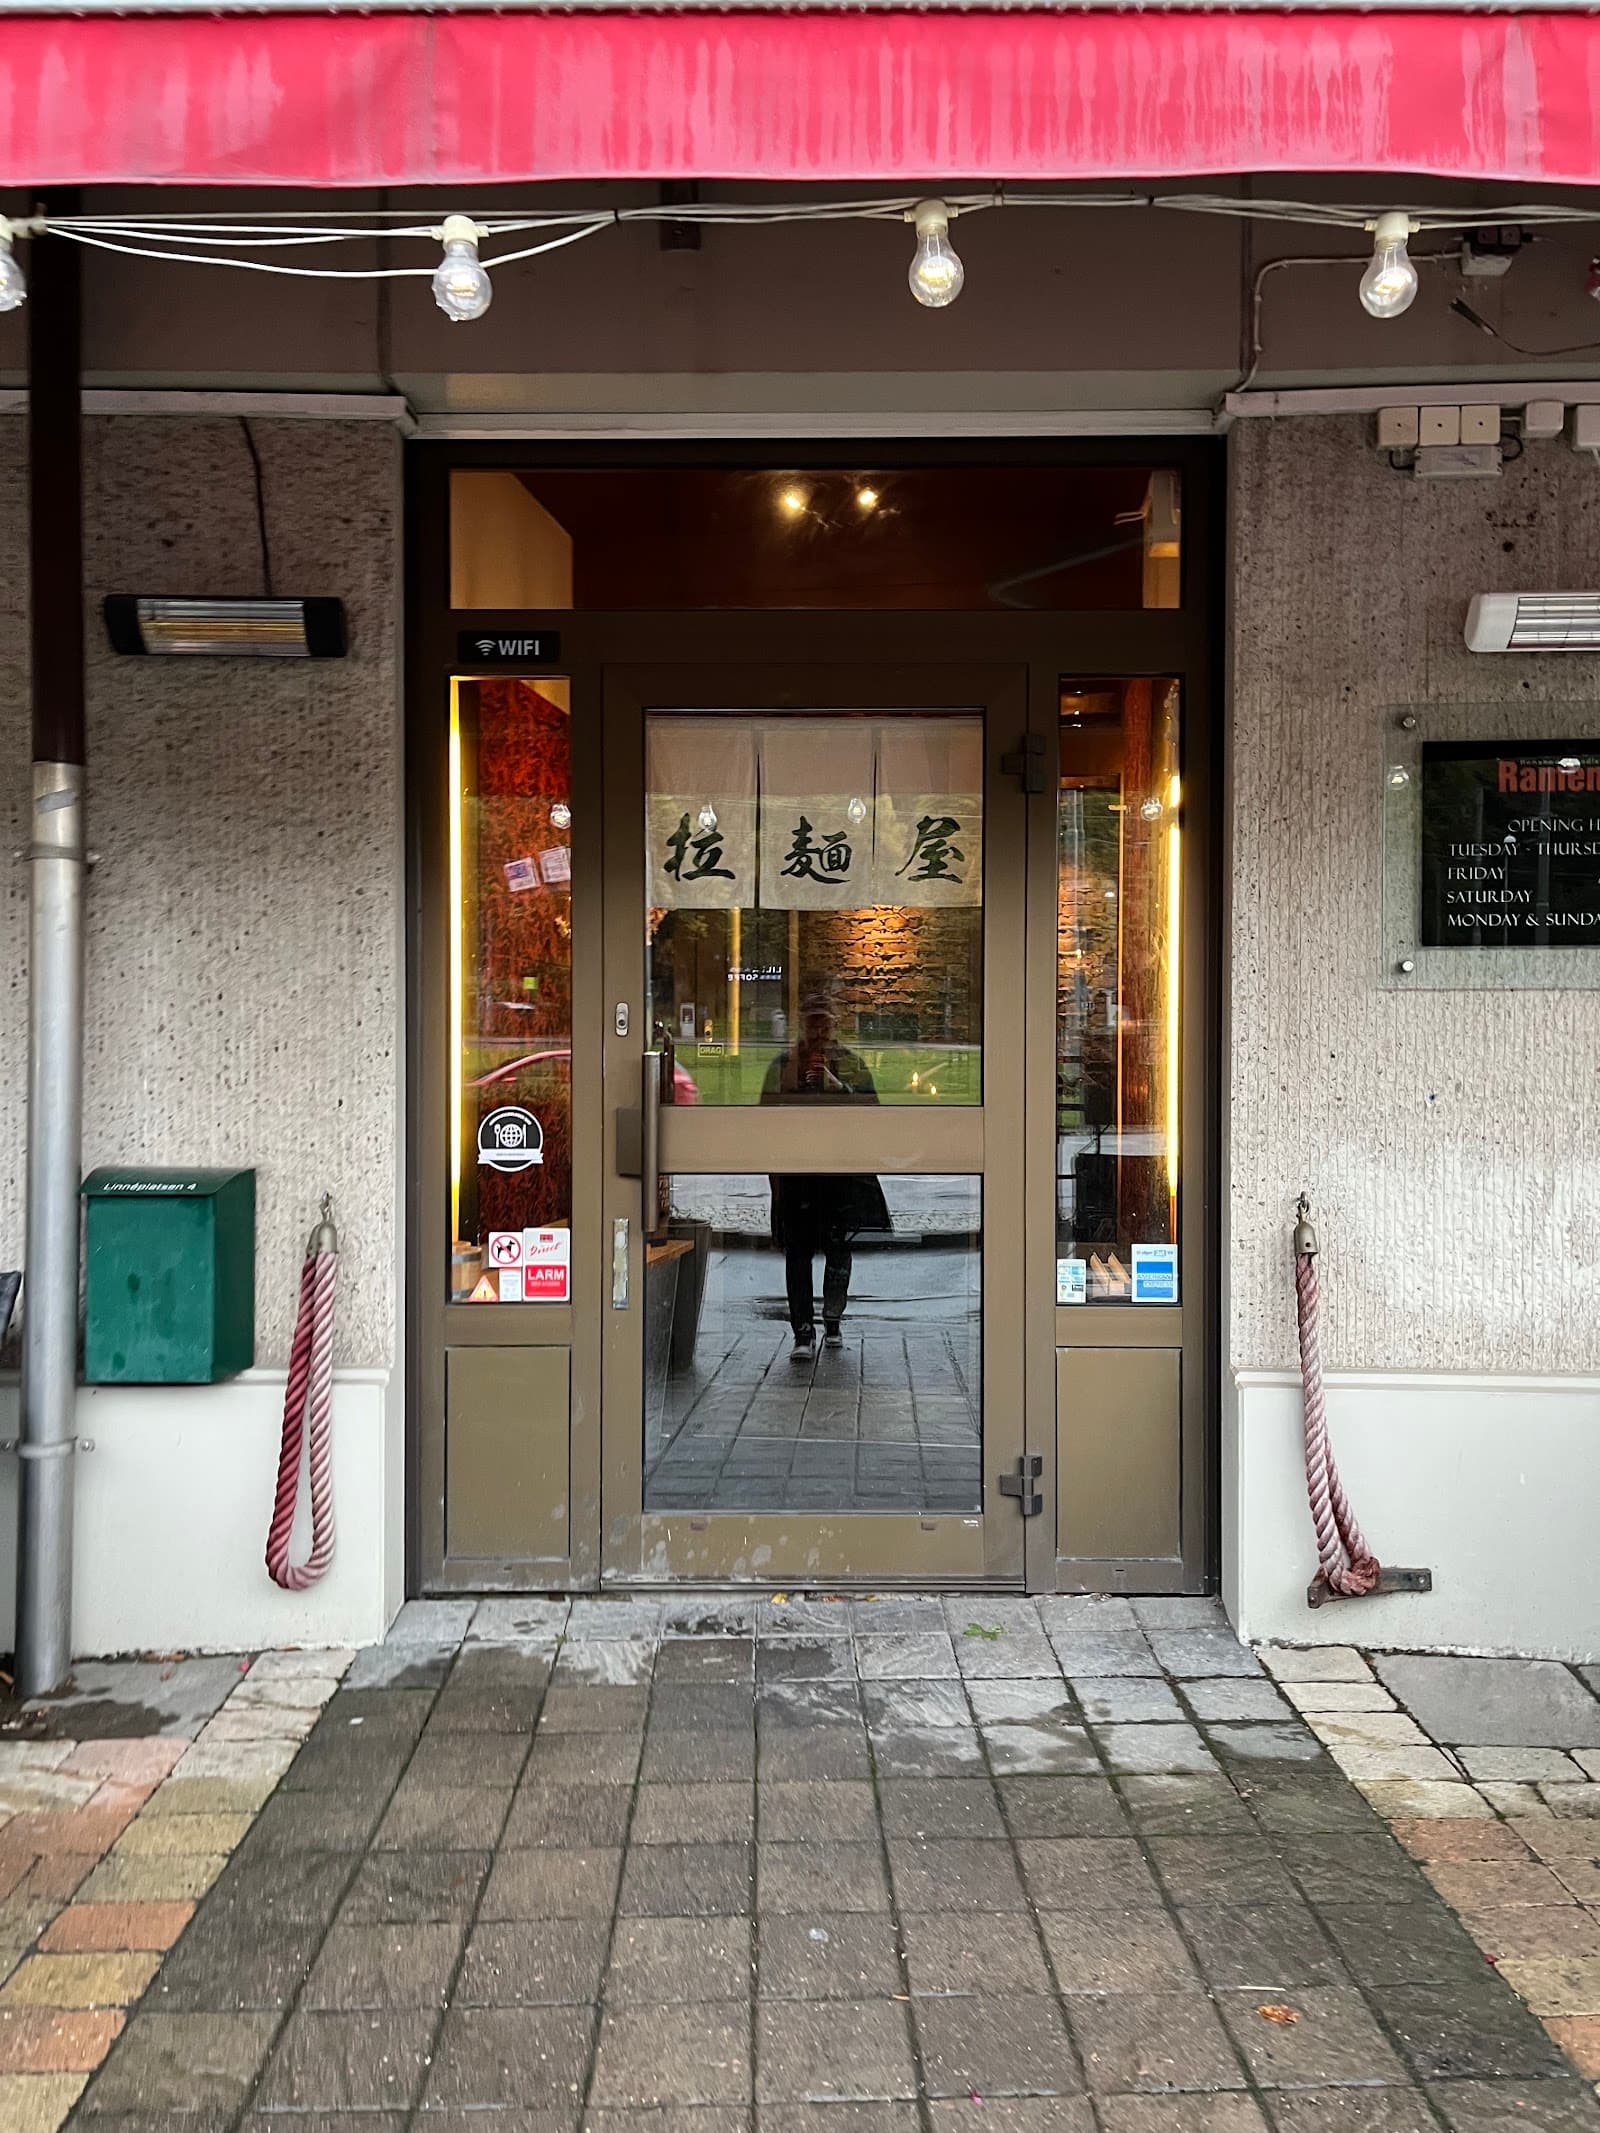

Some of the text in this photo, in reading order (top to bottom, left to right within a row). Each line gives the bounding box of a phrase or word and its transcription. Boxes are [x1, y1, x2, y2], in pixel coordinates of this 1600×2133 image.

[498, 639, 540, 656] WIFI
[1497, 760, 1600, 793] Ramen
[1507, 818, 1584, 832] OPENING
[1447, 843, 1520, 857] TUESDAY
[1447, 866, 1506, 880] FRIDAY
[1446, 889, 1533, 904] SATURDAY
[1447, 913, 1521, 927] MONDAY
[1525, 912, 1540, 927] &
[186, 1183, 197, 1191] 4
[527, 1268, 565, 1281] LARM
